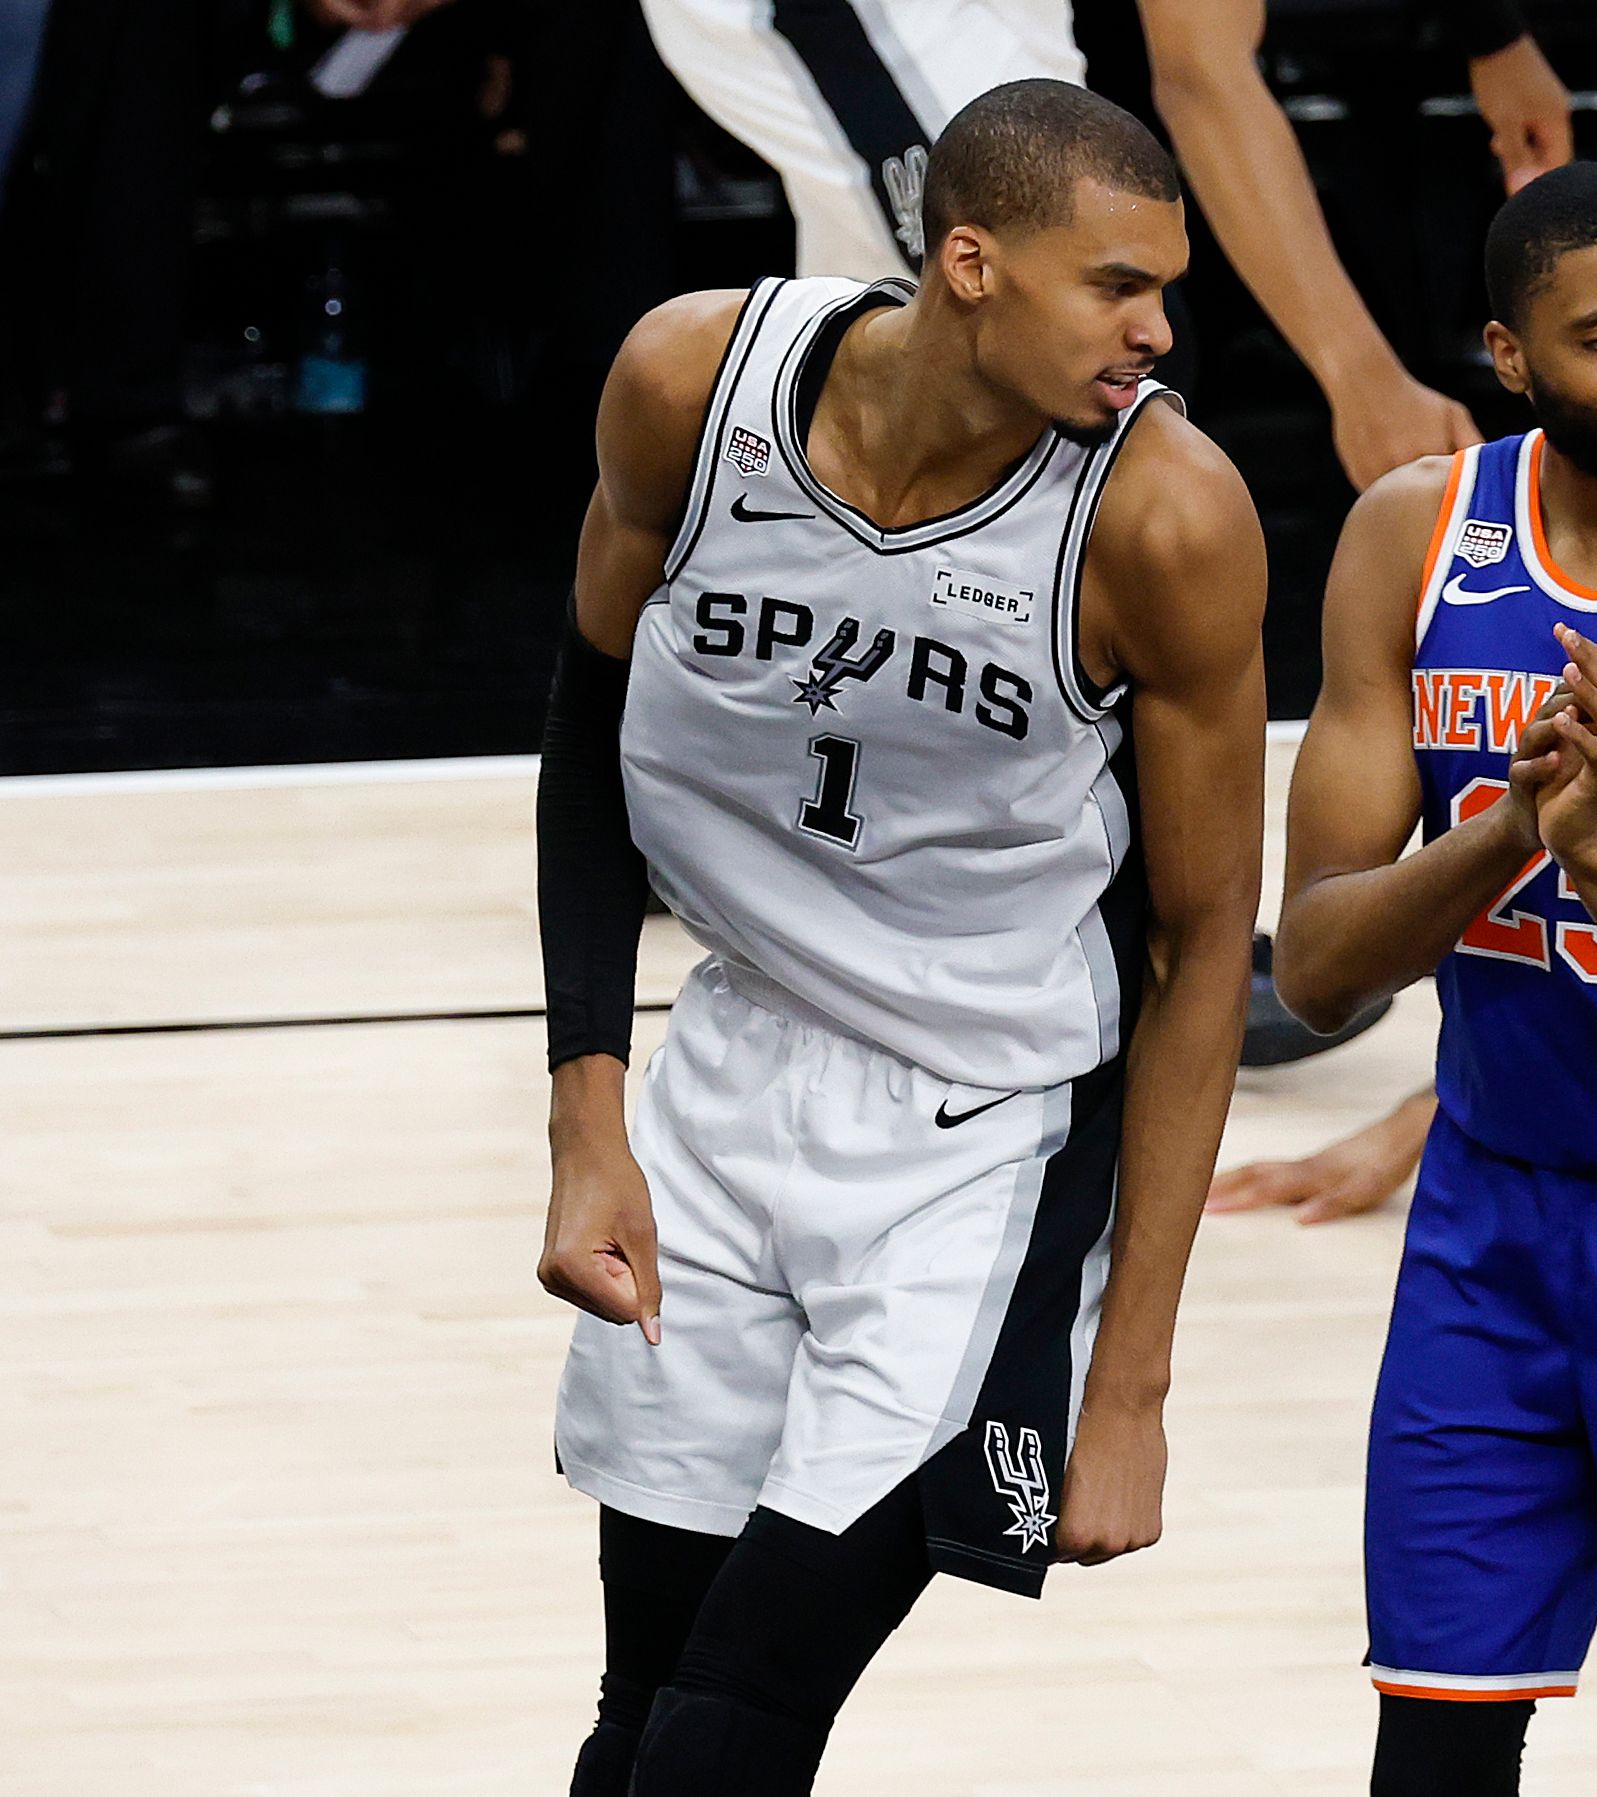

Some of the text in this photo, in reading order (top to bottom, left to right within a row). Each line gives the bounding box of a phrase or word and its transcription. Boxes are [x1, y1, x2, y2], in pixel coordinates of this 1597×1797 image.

[735, 430, 768, 454] USA
[728, 446, 767, 472] 250
[1467, 525, 1504, 541] USA
[1459, 541, 1502, 559] 250
[947, 583, 1019, 613] LEDGER
[693, 591, 1033, 740] SPURS
[1412, 668, 1564, 754] NEW
[799, 732, 864, 851] 1
